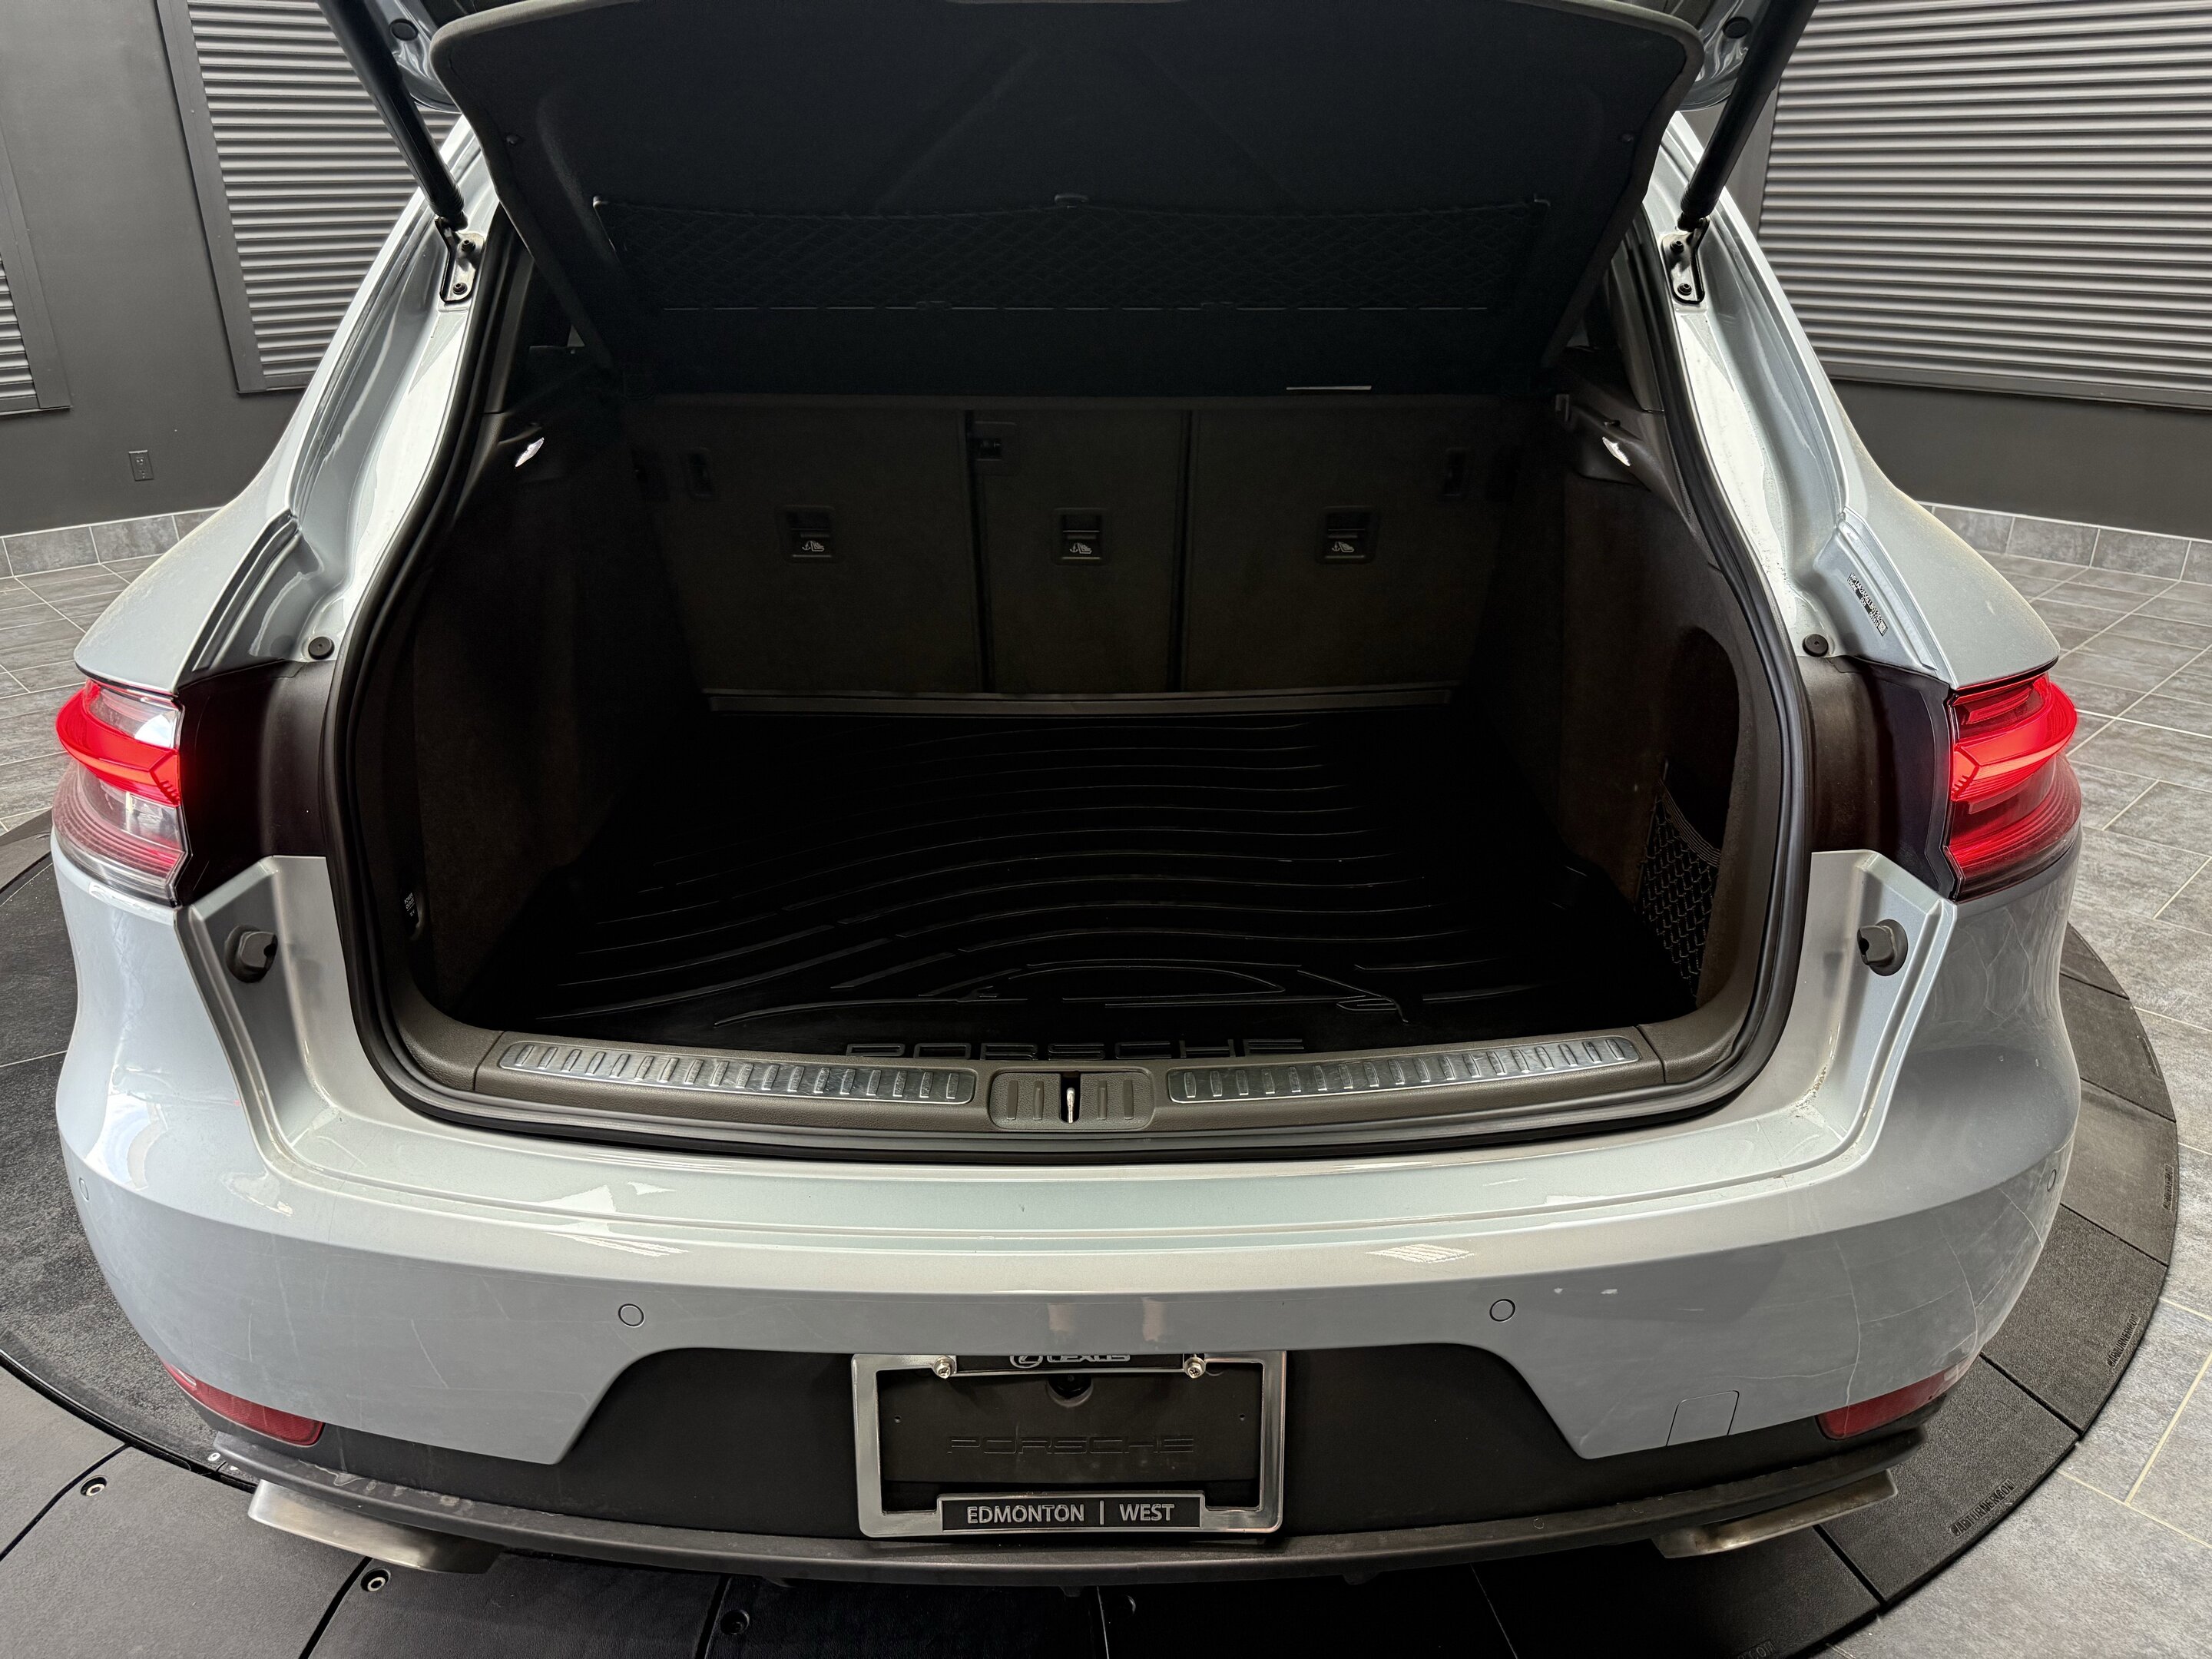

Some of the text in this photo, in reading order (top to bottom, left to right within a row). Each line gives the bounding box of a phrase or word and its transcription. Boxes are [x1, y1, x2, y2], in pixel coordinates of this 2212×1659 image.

[846, 1038, 1303, 1060] PORSCHE
[946, 1435, 1194, 1455] PORSCHE
[967, 1504, 1174, 1525] EDMONTON WEST
